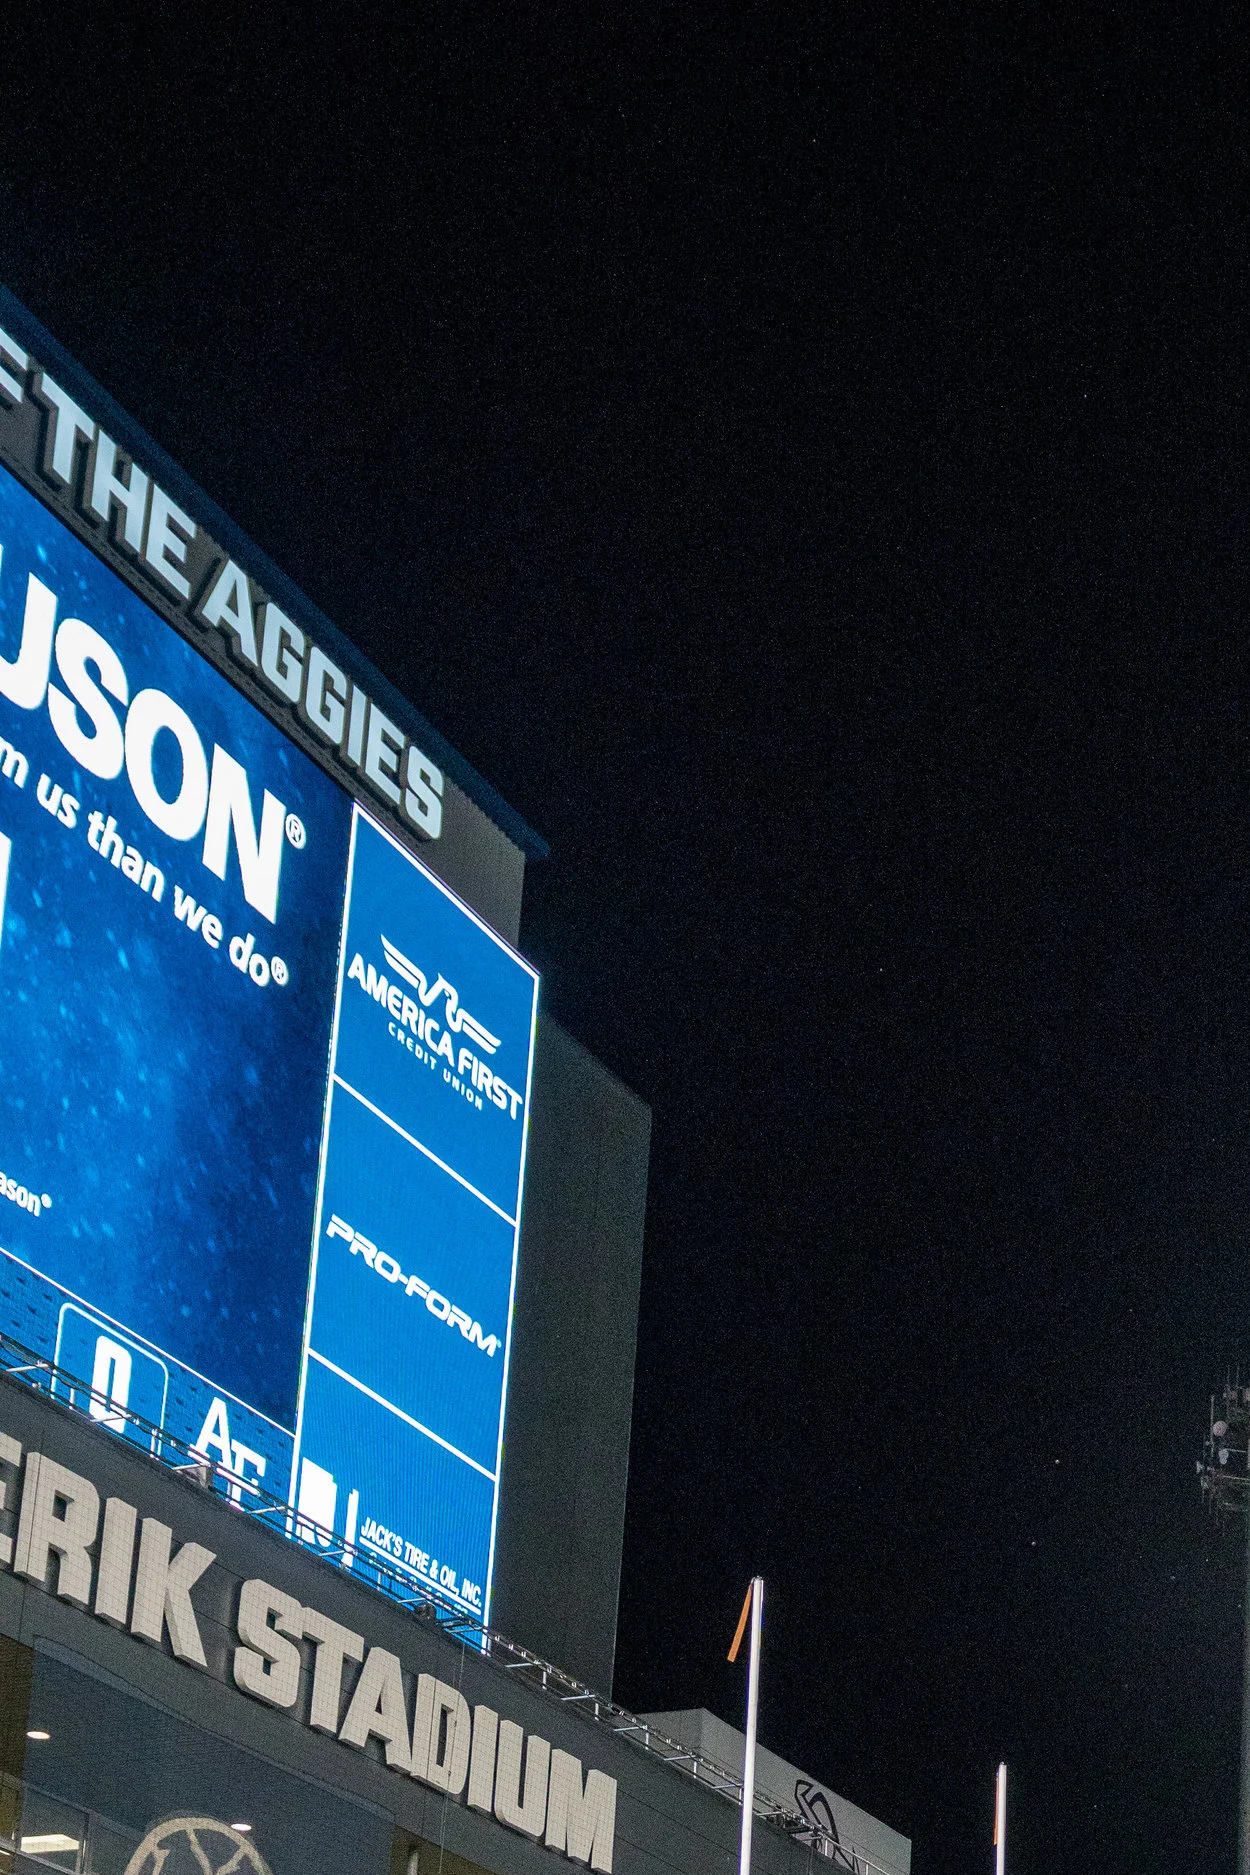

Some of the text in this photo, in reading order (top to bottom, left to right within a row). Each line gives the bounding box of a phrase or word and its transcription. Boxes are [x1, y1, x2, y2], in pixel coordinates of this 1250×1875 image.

[41, 371, 197, 600] THE
[202, 559, 444, 840] AGGIES
[36, 772, 80, 829] us
[87, 809, 166, 903] than
[173, 883, 223, 950] we
[347, 952, 523, 1121] AMERICA FIRST
[388, 1021, 483, 1111] CREDIT UNION
[360, 1517, 404, 1558] JACK'S
[404, 1541, 430, 1575] TIRE
[429, 1559, 439, 1579] &
[439, 1564, 459, 1597] OIL,
[461, 1577, 483, 1608] INC.
[233, 1578, 617, 1874] STADIUM
